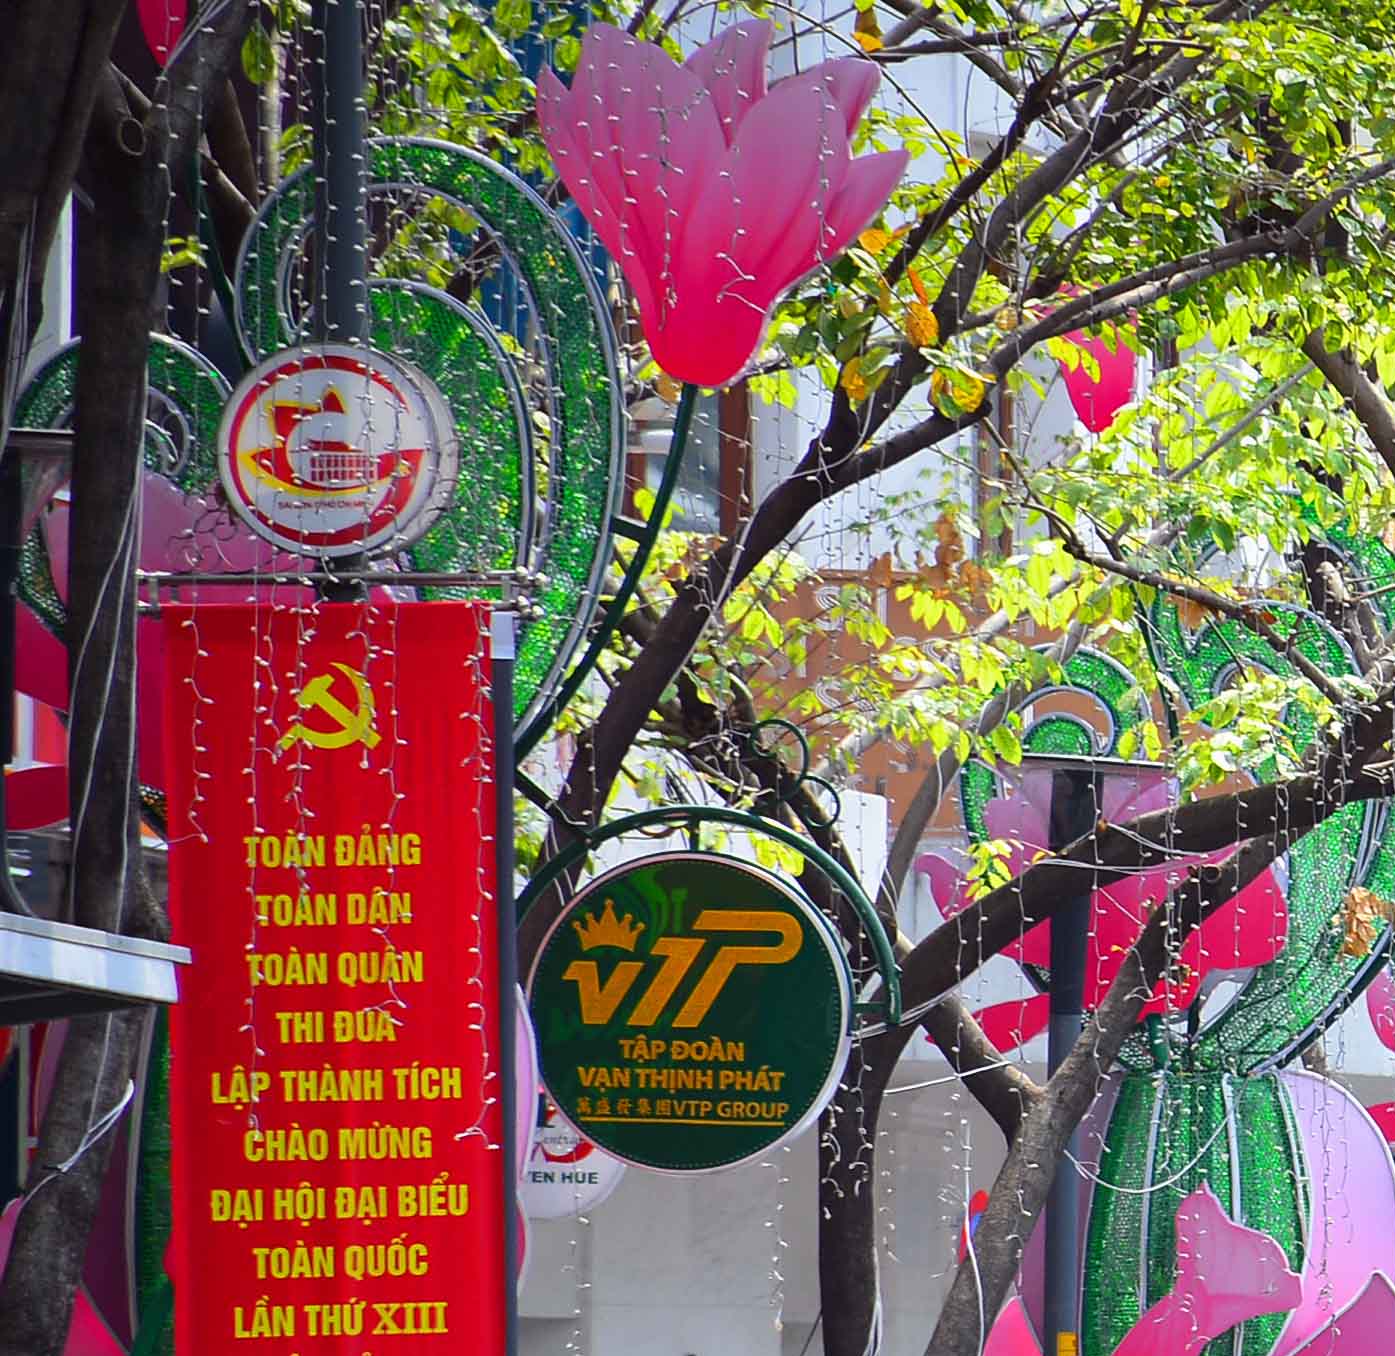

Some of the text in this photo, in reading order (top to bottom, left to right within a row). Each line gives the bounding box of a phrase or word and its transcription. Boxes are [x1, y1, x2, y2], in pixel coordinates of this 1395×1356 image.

[244, 824, 421, 868] TOÀN ĐẢNG
[347, 886, 411, 925] DÂN
[245, 944, 424, 987] TOÀN QUÂN
[275, 1010, 397, 1043] THI ĐUA
[619, 1034, 745, 1063] TẬP ĐOÀN
[211, 1061, 462, 1110] LẬP THÀNH TÍCH
[577, 1065, 785, 1094] VẠN THỊNH PHÁT
[673, 1100, 789, 1119] VTP GROUP
[244, 1121, 432, 1162] CHÀO MỪNG
[210, 1172, 469, 1229] ĐẠI HỘI ĐẠI BIỂU
[252, 1232, 429, 1281] TOÀN QUỐC
[233, 1295, 448, 1339] LẦN THỨ XIII
